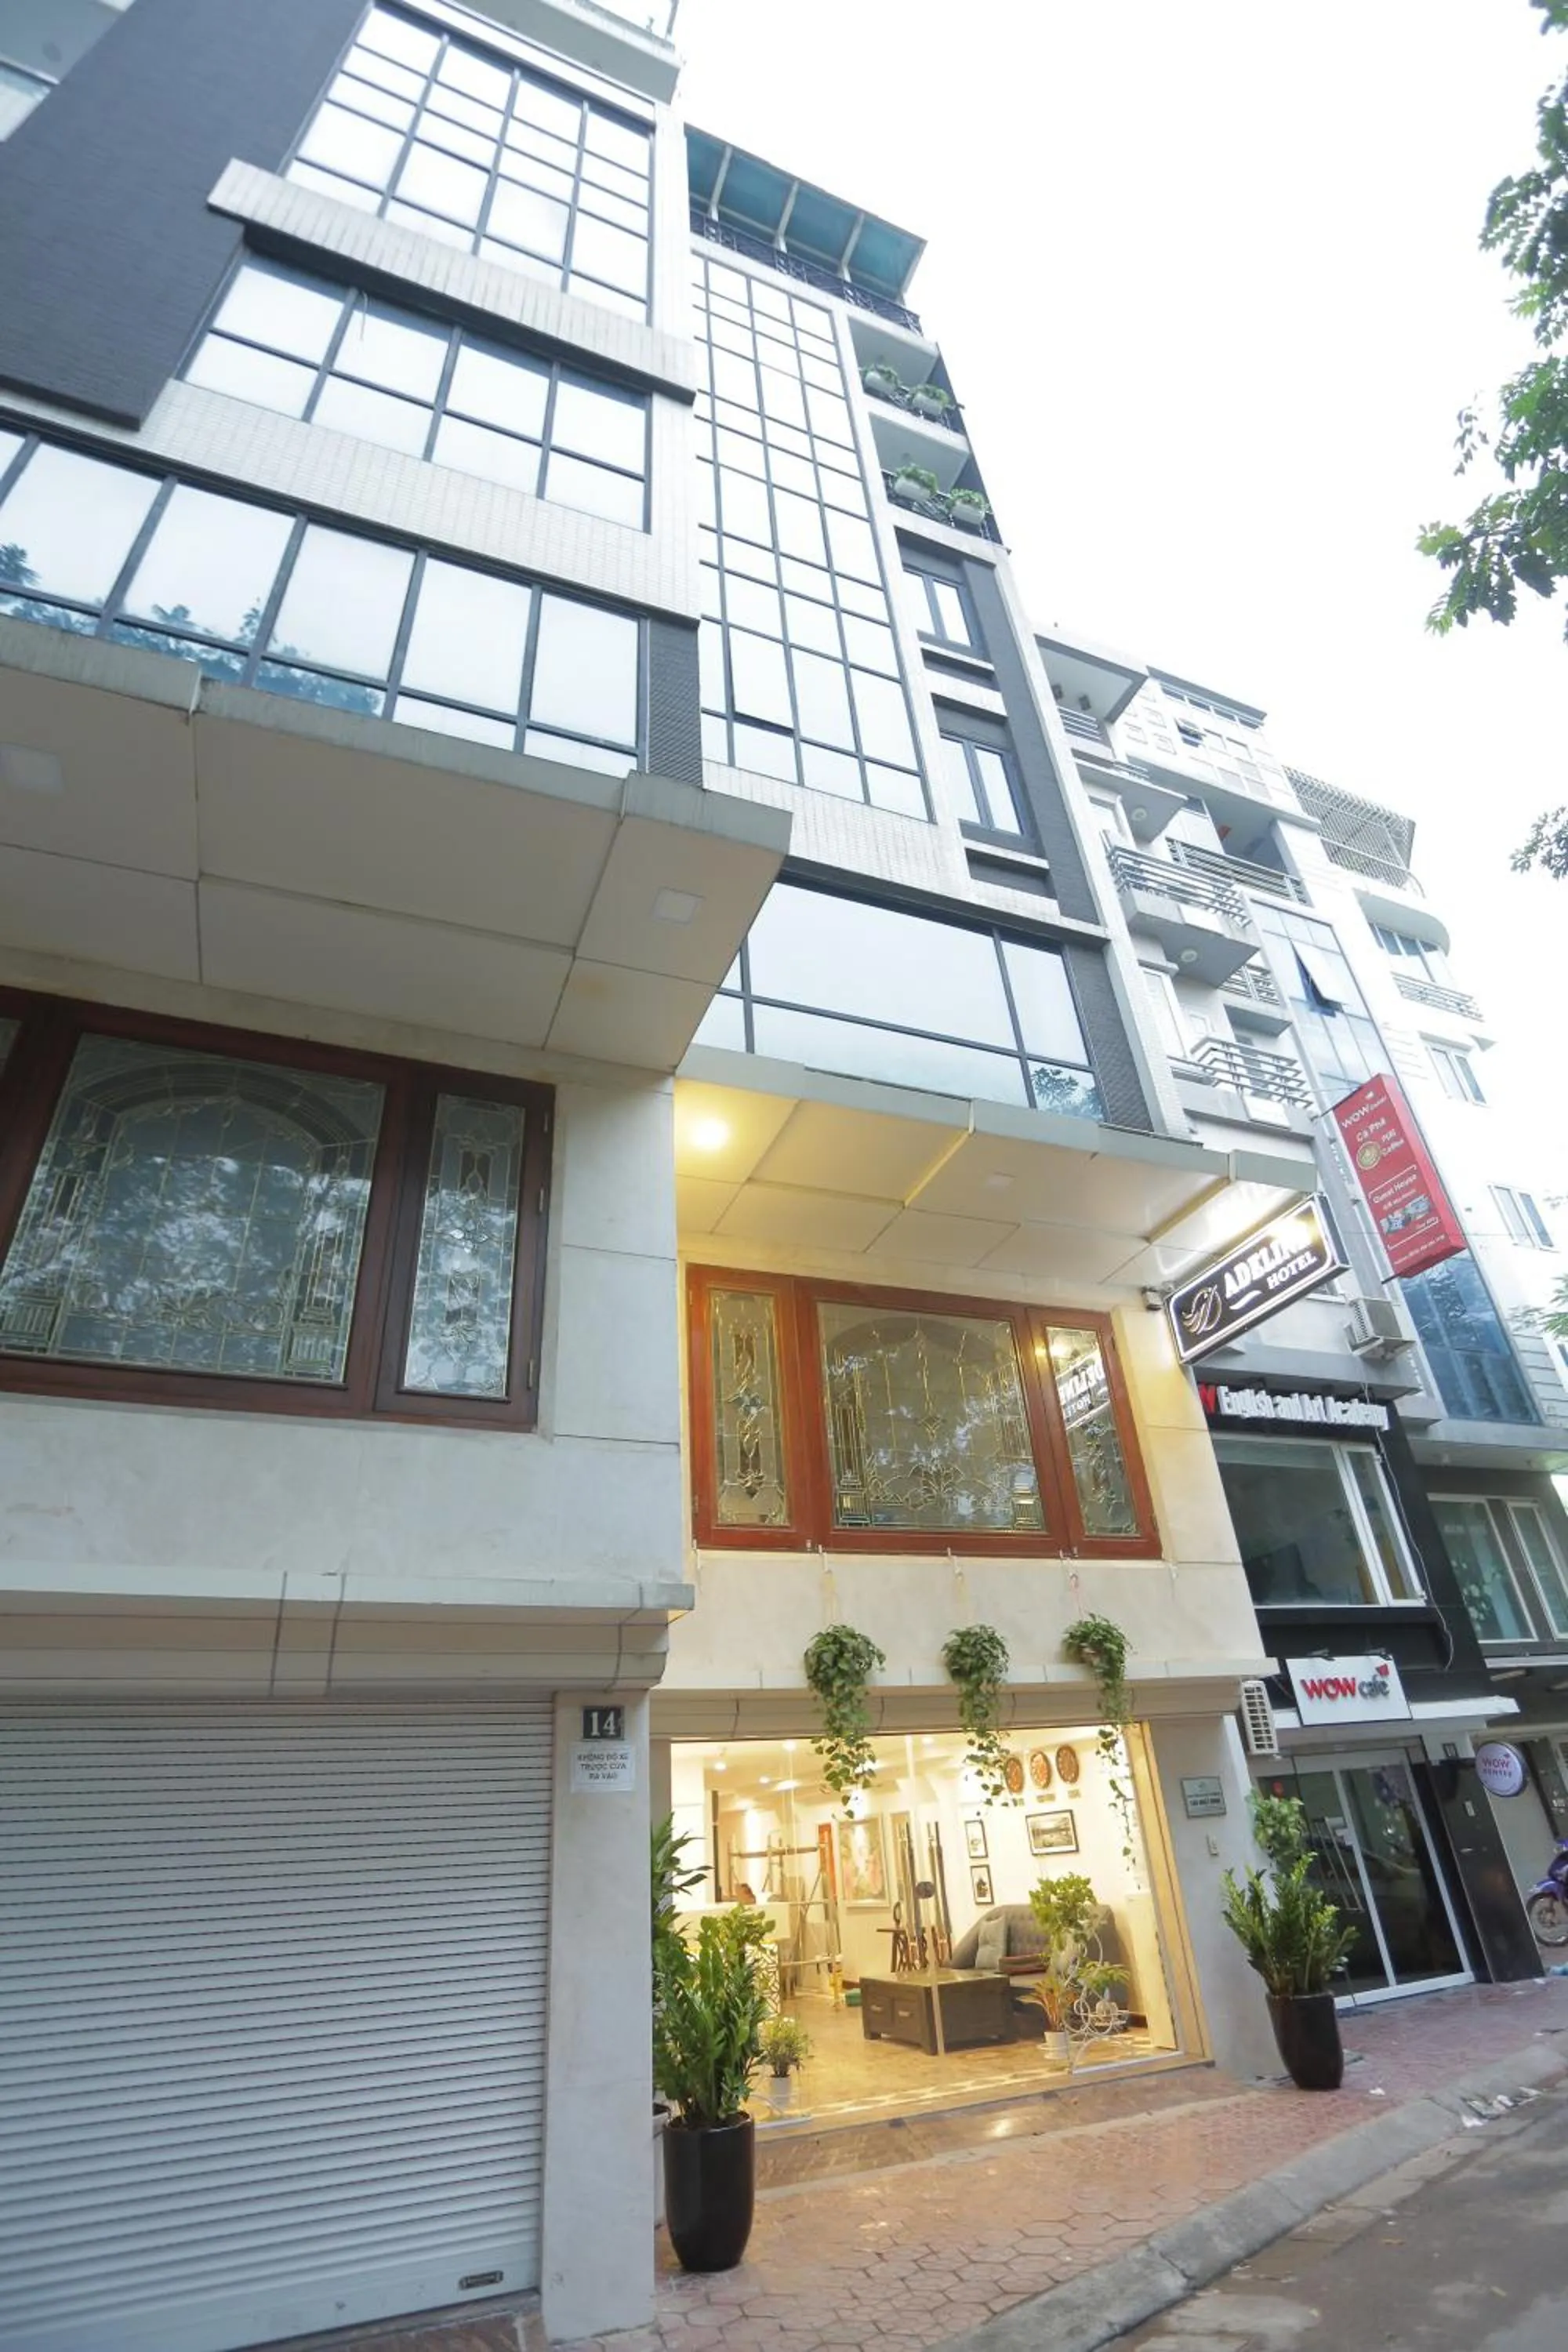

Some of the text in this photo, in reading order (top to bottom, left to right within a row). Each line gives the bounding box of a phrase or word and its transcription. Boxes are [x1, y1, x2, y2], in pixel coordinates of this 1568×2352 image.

[1341, 1104, 1370, 1128] WOW
[1224, 1220, 1314, 1299] ADELIN
[1266, 1250, 1318, 1290] HOTEL
[1300, 1677, 1356, 1702] WOW
[590, 1711, 616, 1737] 14
[1482, 1758, 1510, 1769] WOW
